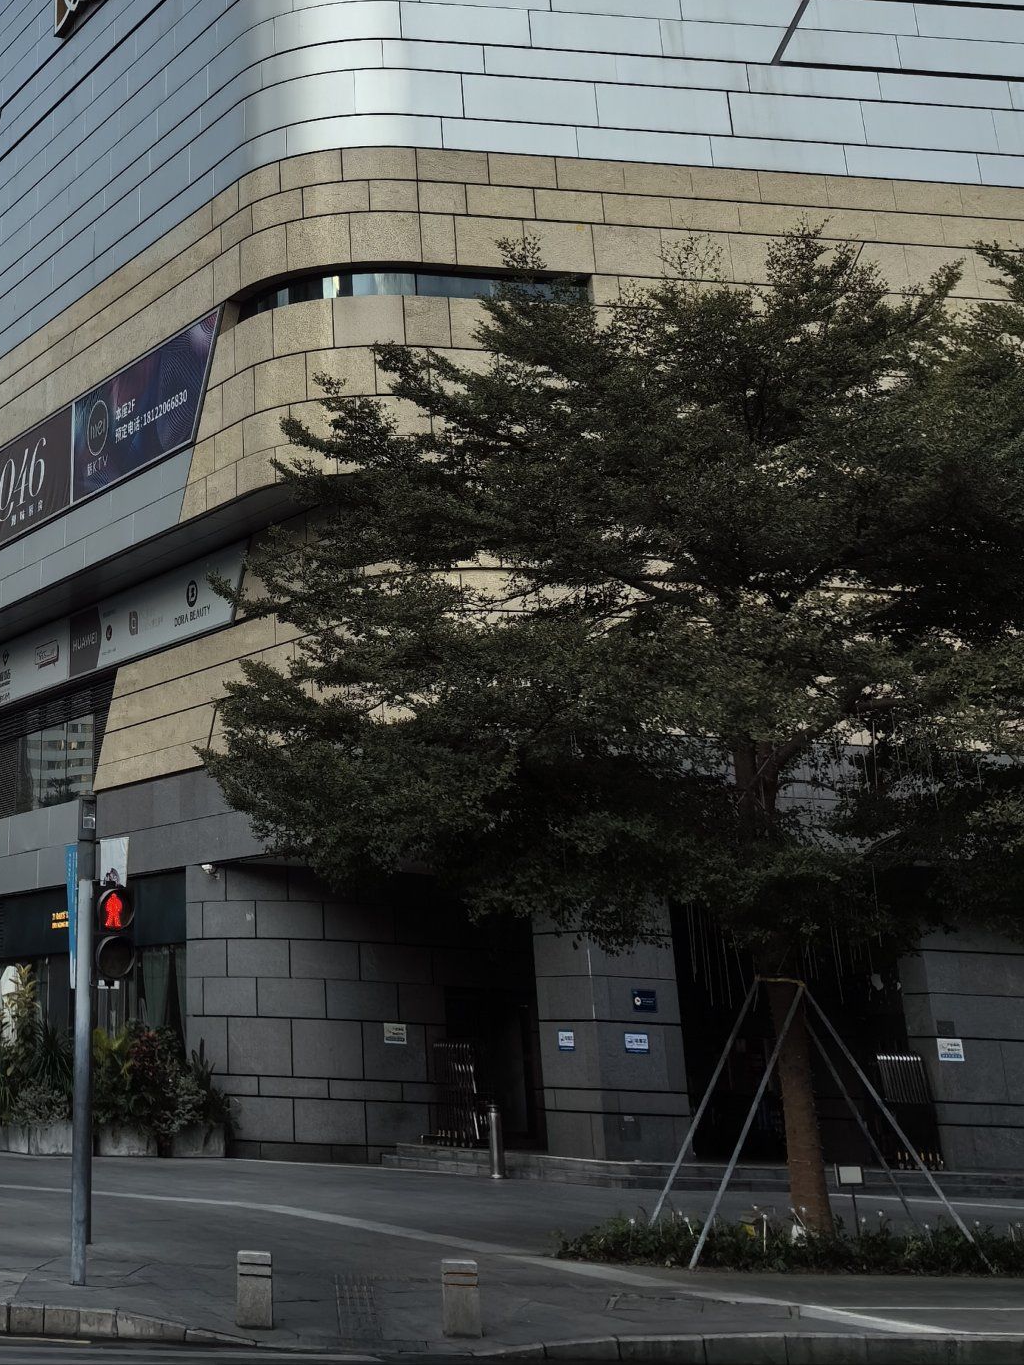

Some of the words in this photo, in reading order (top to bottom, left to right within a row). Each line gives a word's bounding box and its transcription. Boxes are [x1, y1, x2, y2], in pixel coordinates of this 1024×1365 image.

[174, 613, 189, 627] DORA
[189, 604, 211, 621] BEAUTY
[72, 632, 98, 652] HUAWEI
